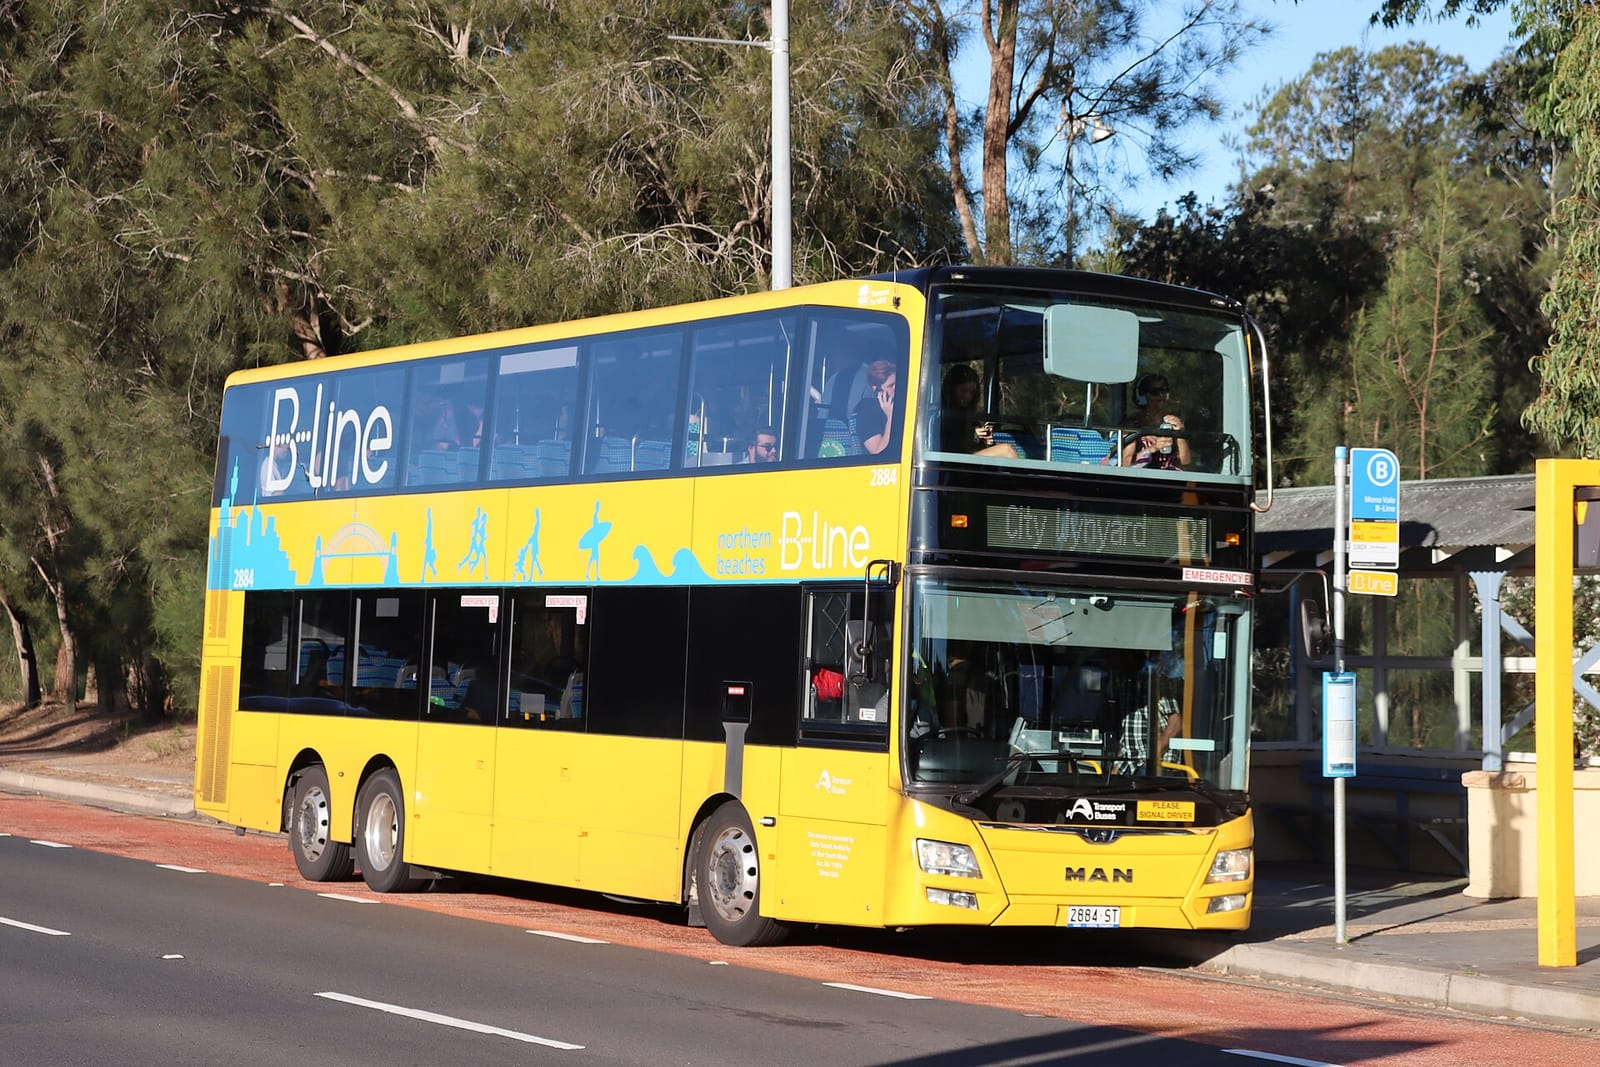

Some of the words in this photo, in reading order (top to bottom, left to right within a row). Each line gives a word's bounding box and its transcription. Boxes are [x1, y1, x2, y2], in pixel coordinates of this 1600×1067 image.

[870, 467, 897, 487] 2884
[1375, 460, 1389, 480] B
[1364, 495, 1382, 504] Mona
[1382, 496, 1396, 505] Vale
[1005, 505, 1048, 550] City
[1056, 508, 1147, 554] Wynyard
[717, 527, 772, 549] northern
[716, 552, 766, 575] beaches
[233, 568, 255, 588] 2884
[1185, 570, 1243, 583] EMERGENCY
[1093, 801, 1126, 813] Transport
[1152, 802, 1181, 810] PLEASE
[1094, 811, 1117, 821] Buses
[1139, 811, 1164, 819] SIGNAL
[1164, 811, 1193, 820] DRIVER
[1065, 867, 1133, 883] MAN
[1070, 908, 1098, 923] 2884
[1104, 908, 1119, 923] ST
